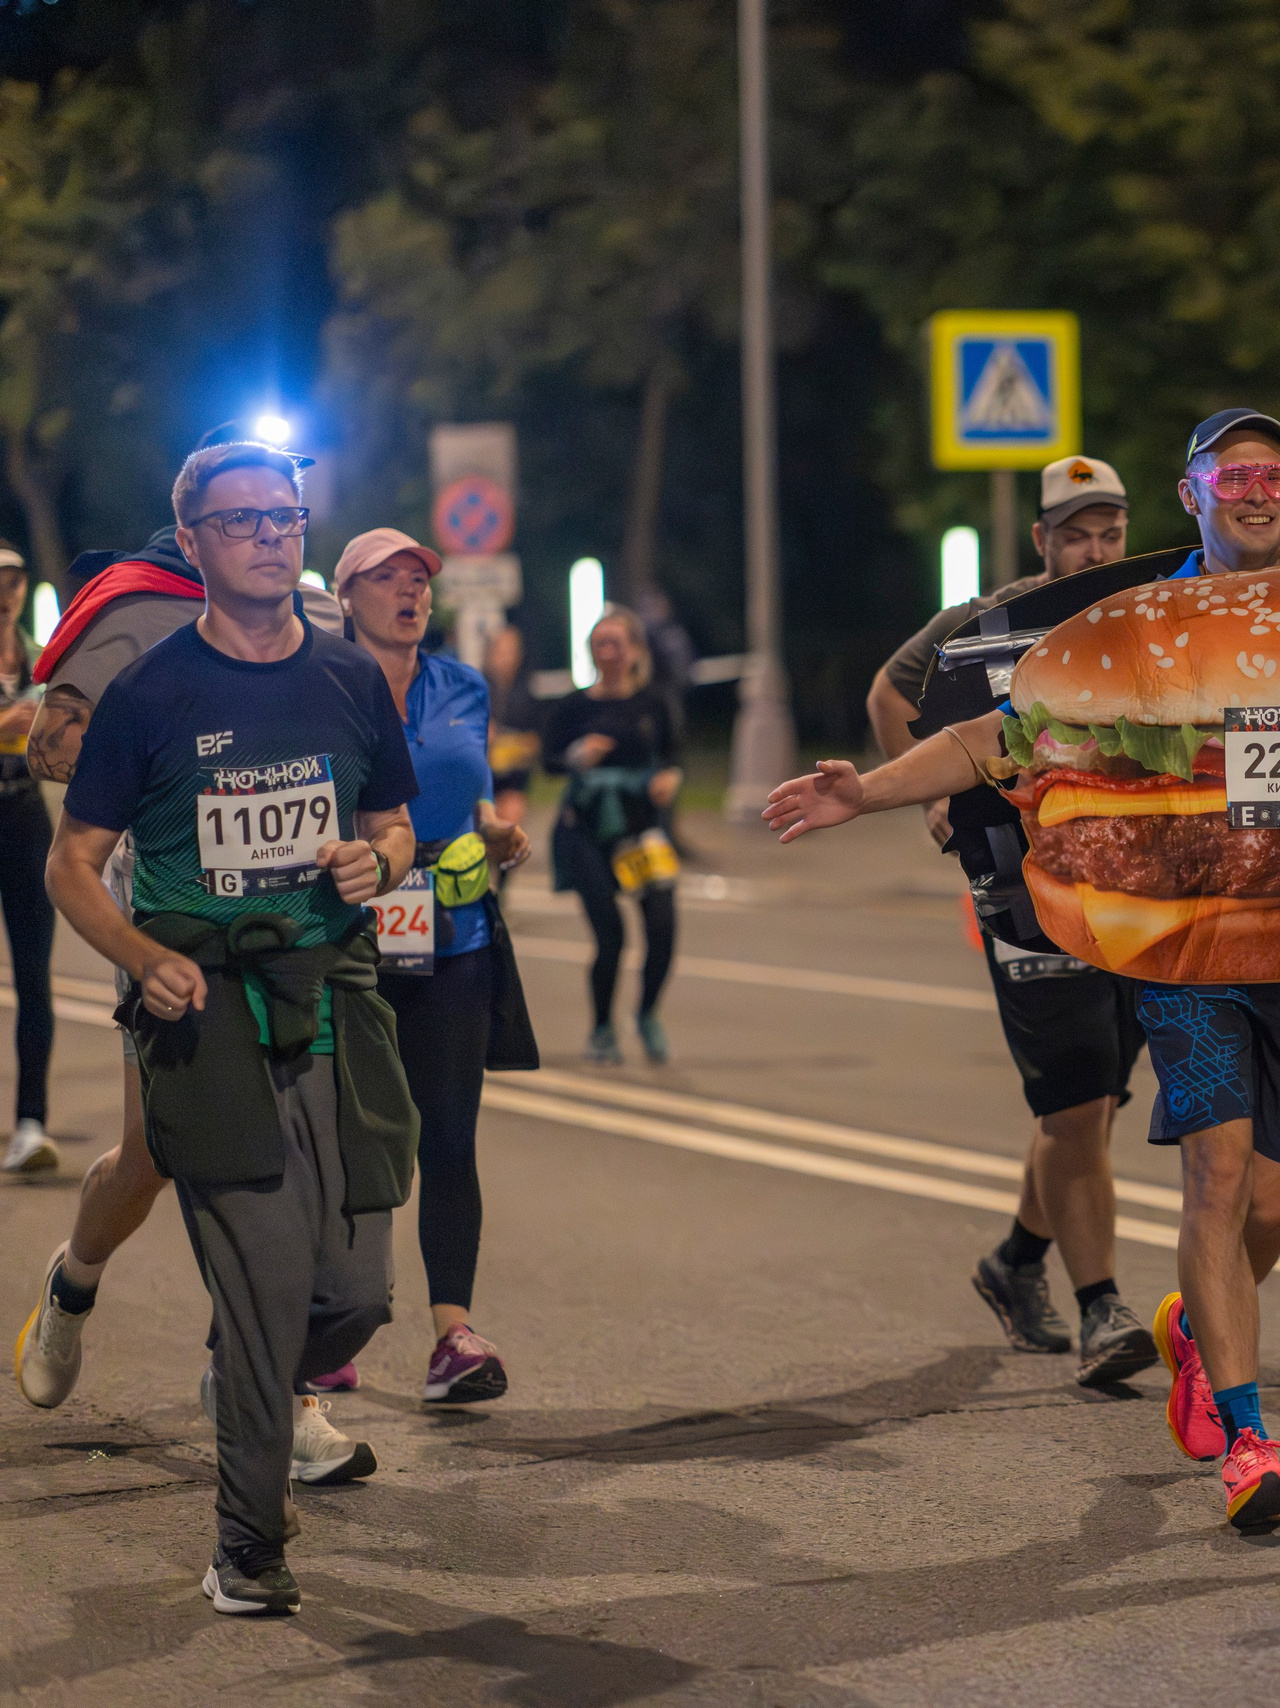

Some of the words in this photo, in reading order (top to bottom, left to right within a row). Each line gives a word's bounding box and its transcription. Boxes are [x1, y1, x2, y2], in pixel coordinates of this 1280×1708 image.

[206, 795, 332, 846] 11079
[1241, 806, 1256, 827] E
[250, 844, 295, 861] АНТОН
[220, 873, 238, 894] G
